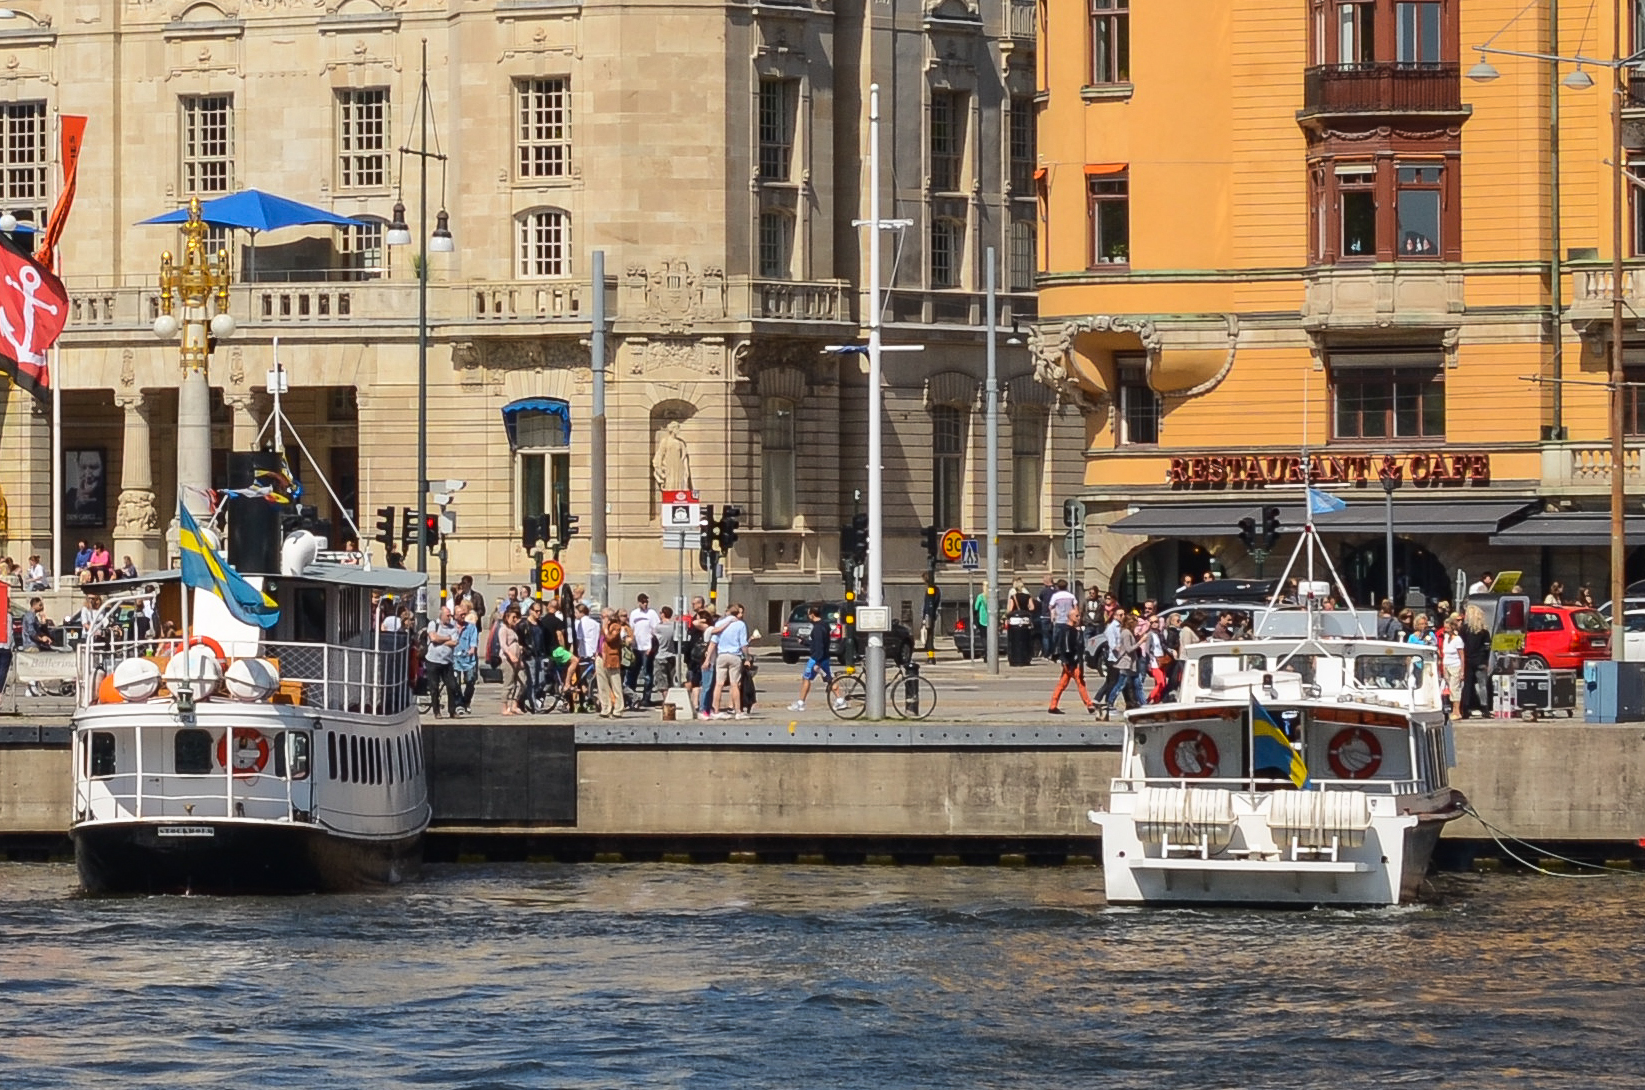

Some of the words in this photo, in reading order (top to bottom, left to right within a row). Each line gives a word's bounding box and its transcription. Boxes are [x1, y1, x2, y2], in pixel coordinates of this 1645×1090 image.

[1170, 456, 1372, 482] RESTAURANT
[946, 537, 962, 552] 30
[542, 568, 560, 582] 30
